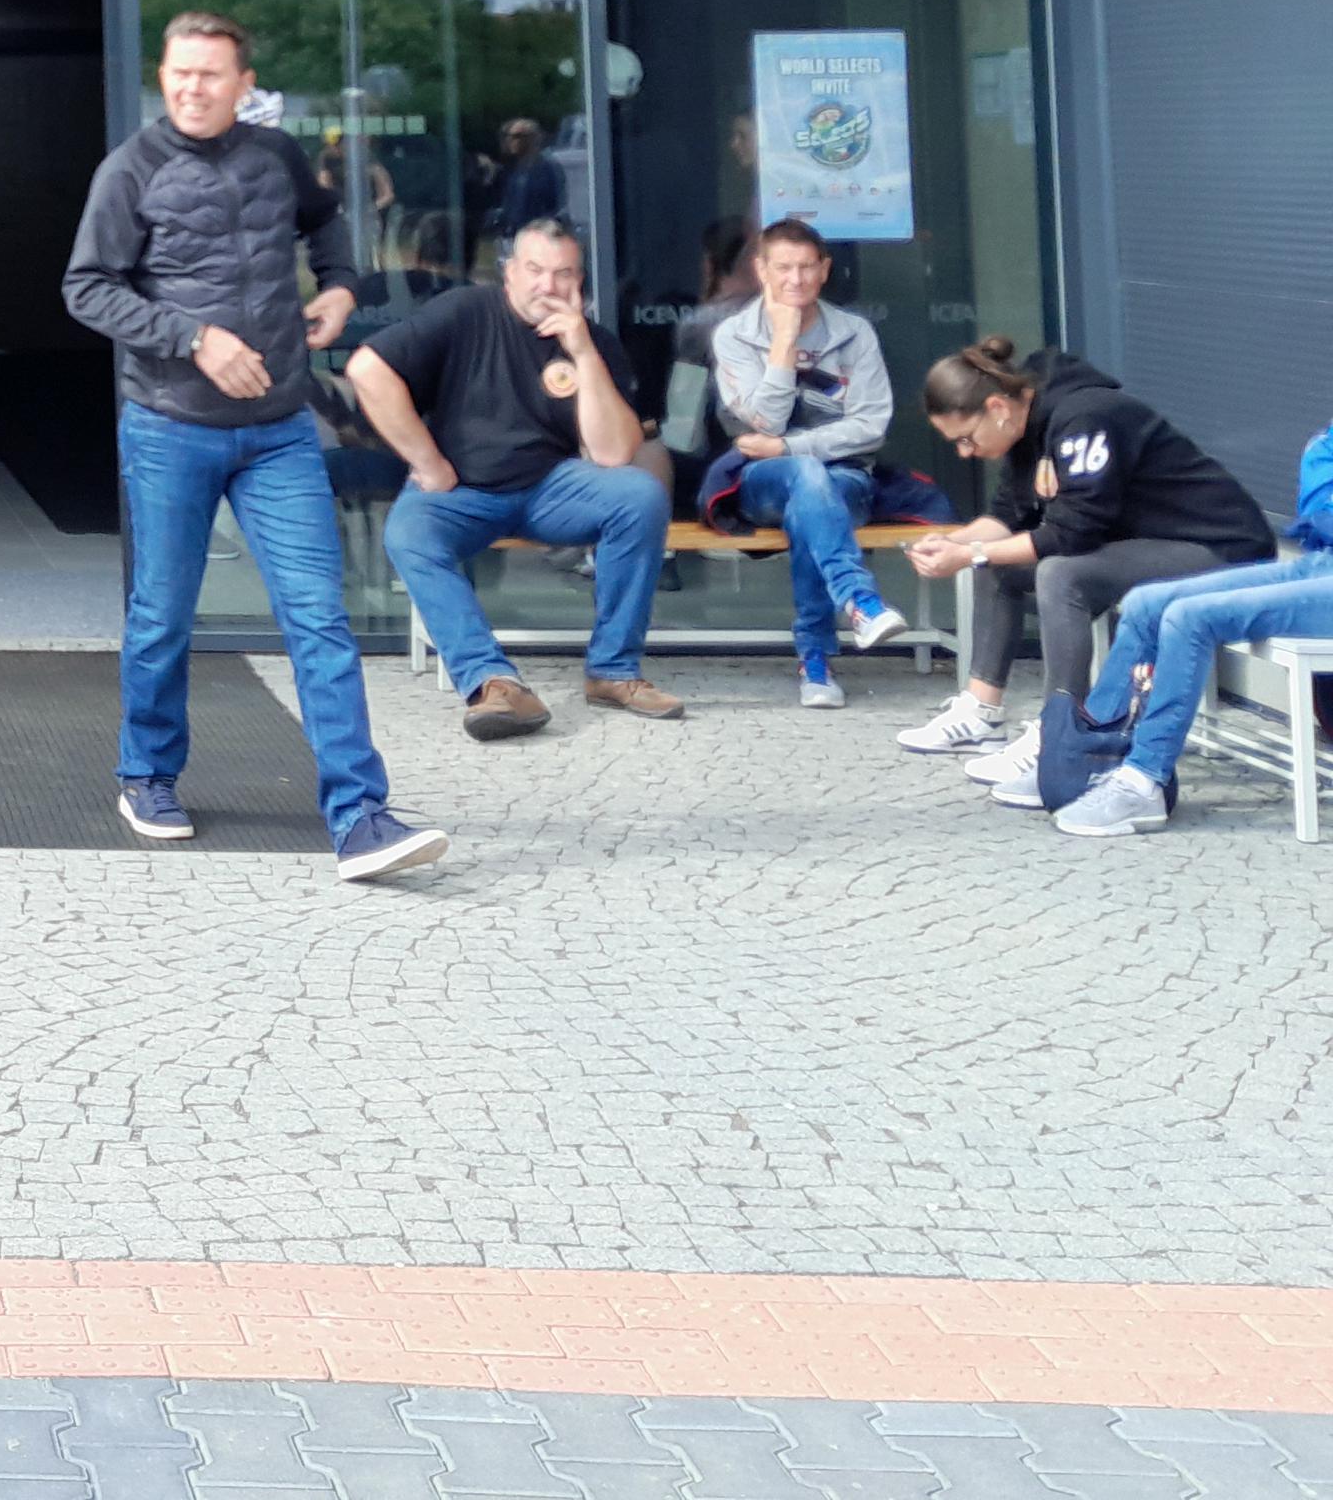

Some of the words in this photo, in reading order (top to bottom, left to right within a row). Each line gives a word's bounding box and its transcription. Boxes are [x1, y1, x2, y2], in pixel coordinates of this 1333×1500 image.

[779, 58, 825, 75] WORLD
[827, 57, 882, 74] SELECTS
[811, 78, 851, 94] INVITE
